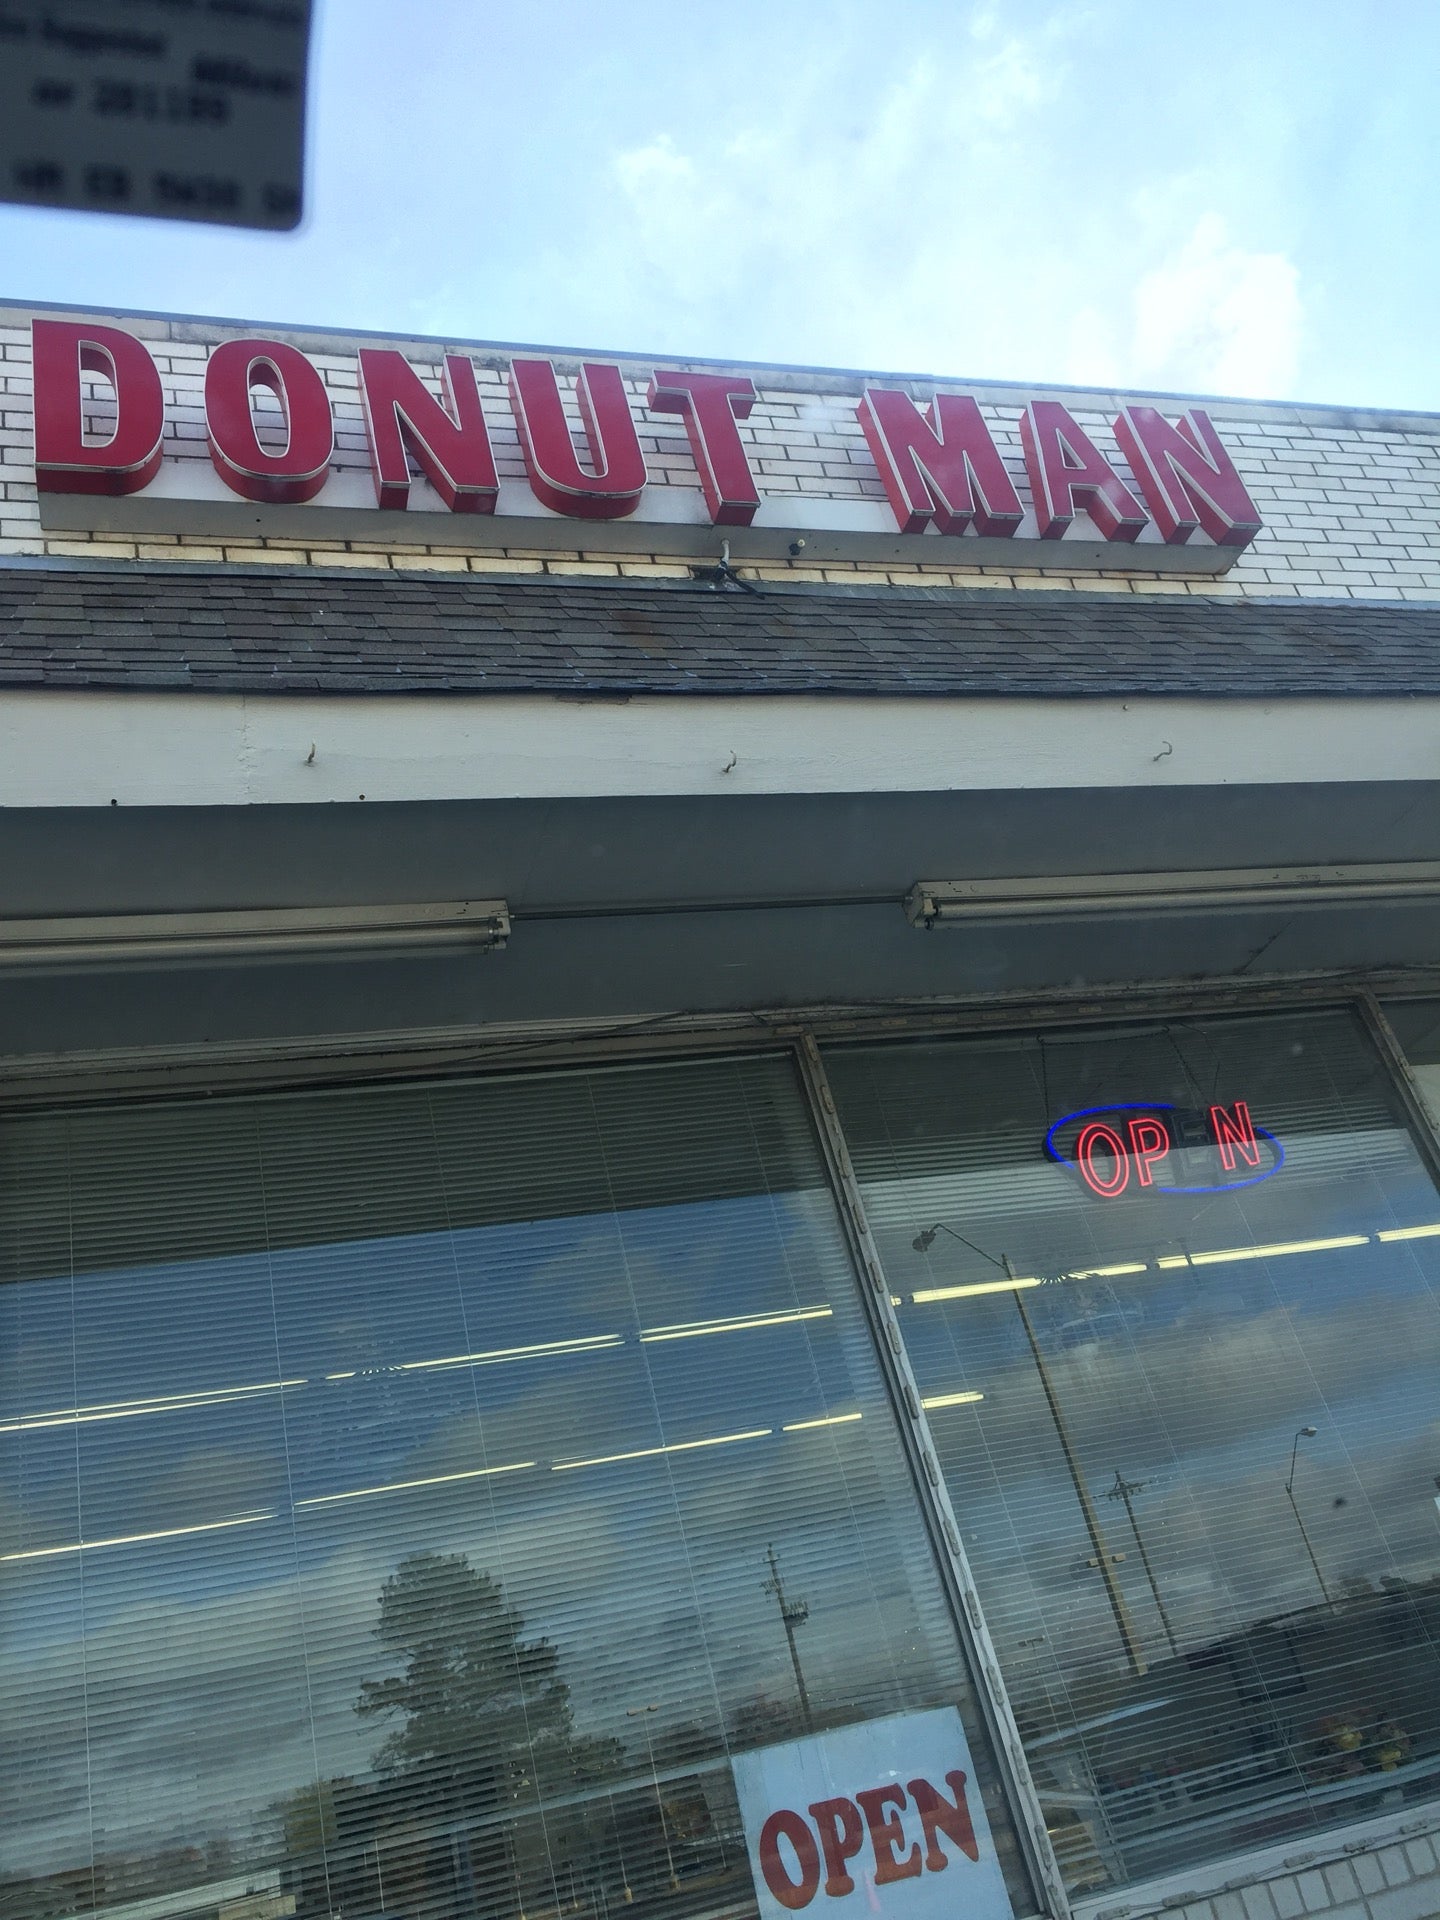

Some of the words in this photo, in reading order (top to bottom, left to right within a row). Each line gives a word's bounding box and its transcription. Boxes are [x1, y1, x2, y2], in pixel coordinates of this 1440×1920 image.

[32, 319, 758, 527] DONUT
[856, 388, 1263, 547] MAN
[759, 1770, 980, 1910] OPEN
